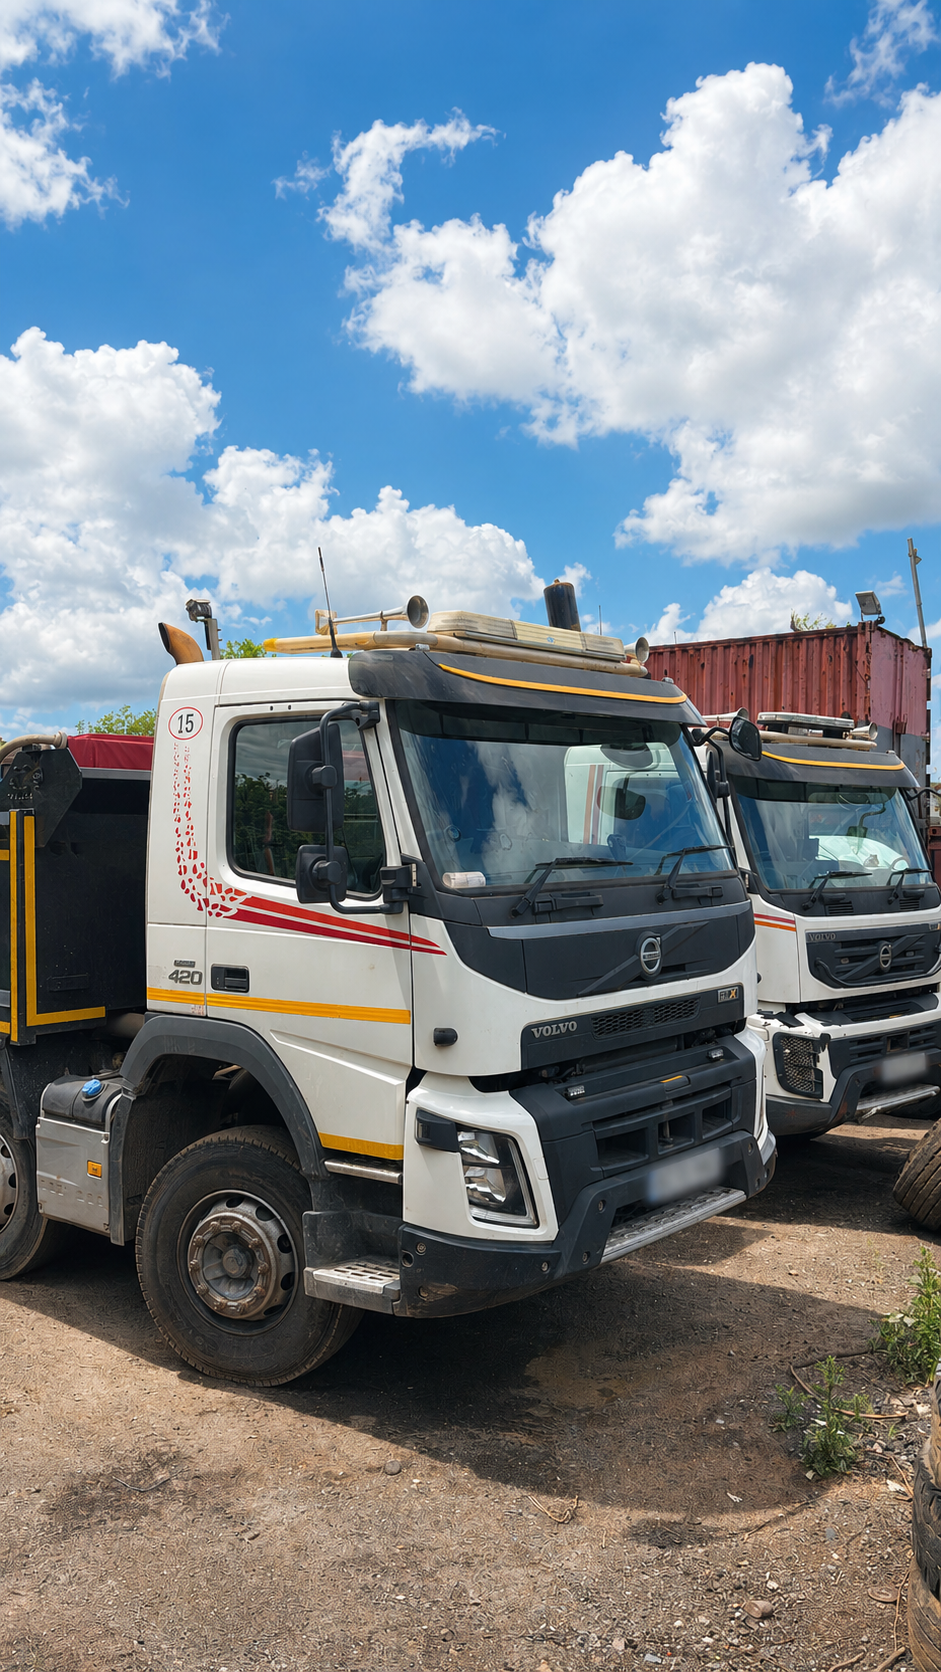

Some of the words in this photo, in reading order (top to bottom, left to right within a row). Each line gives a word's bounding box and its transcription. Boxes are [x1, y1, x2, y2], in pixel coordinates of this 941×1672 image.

[178, 713, 194, 734] 15
[168, 969, 203, 985] 420
[531, 1020, 578, 1038] VOLVO
